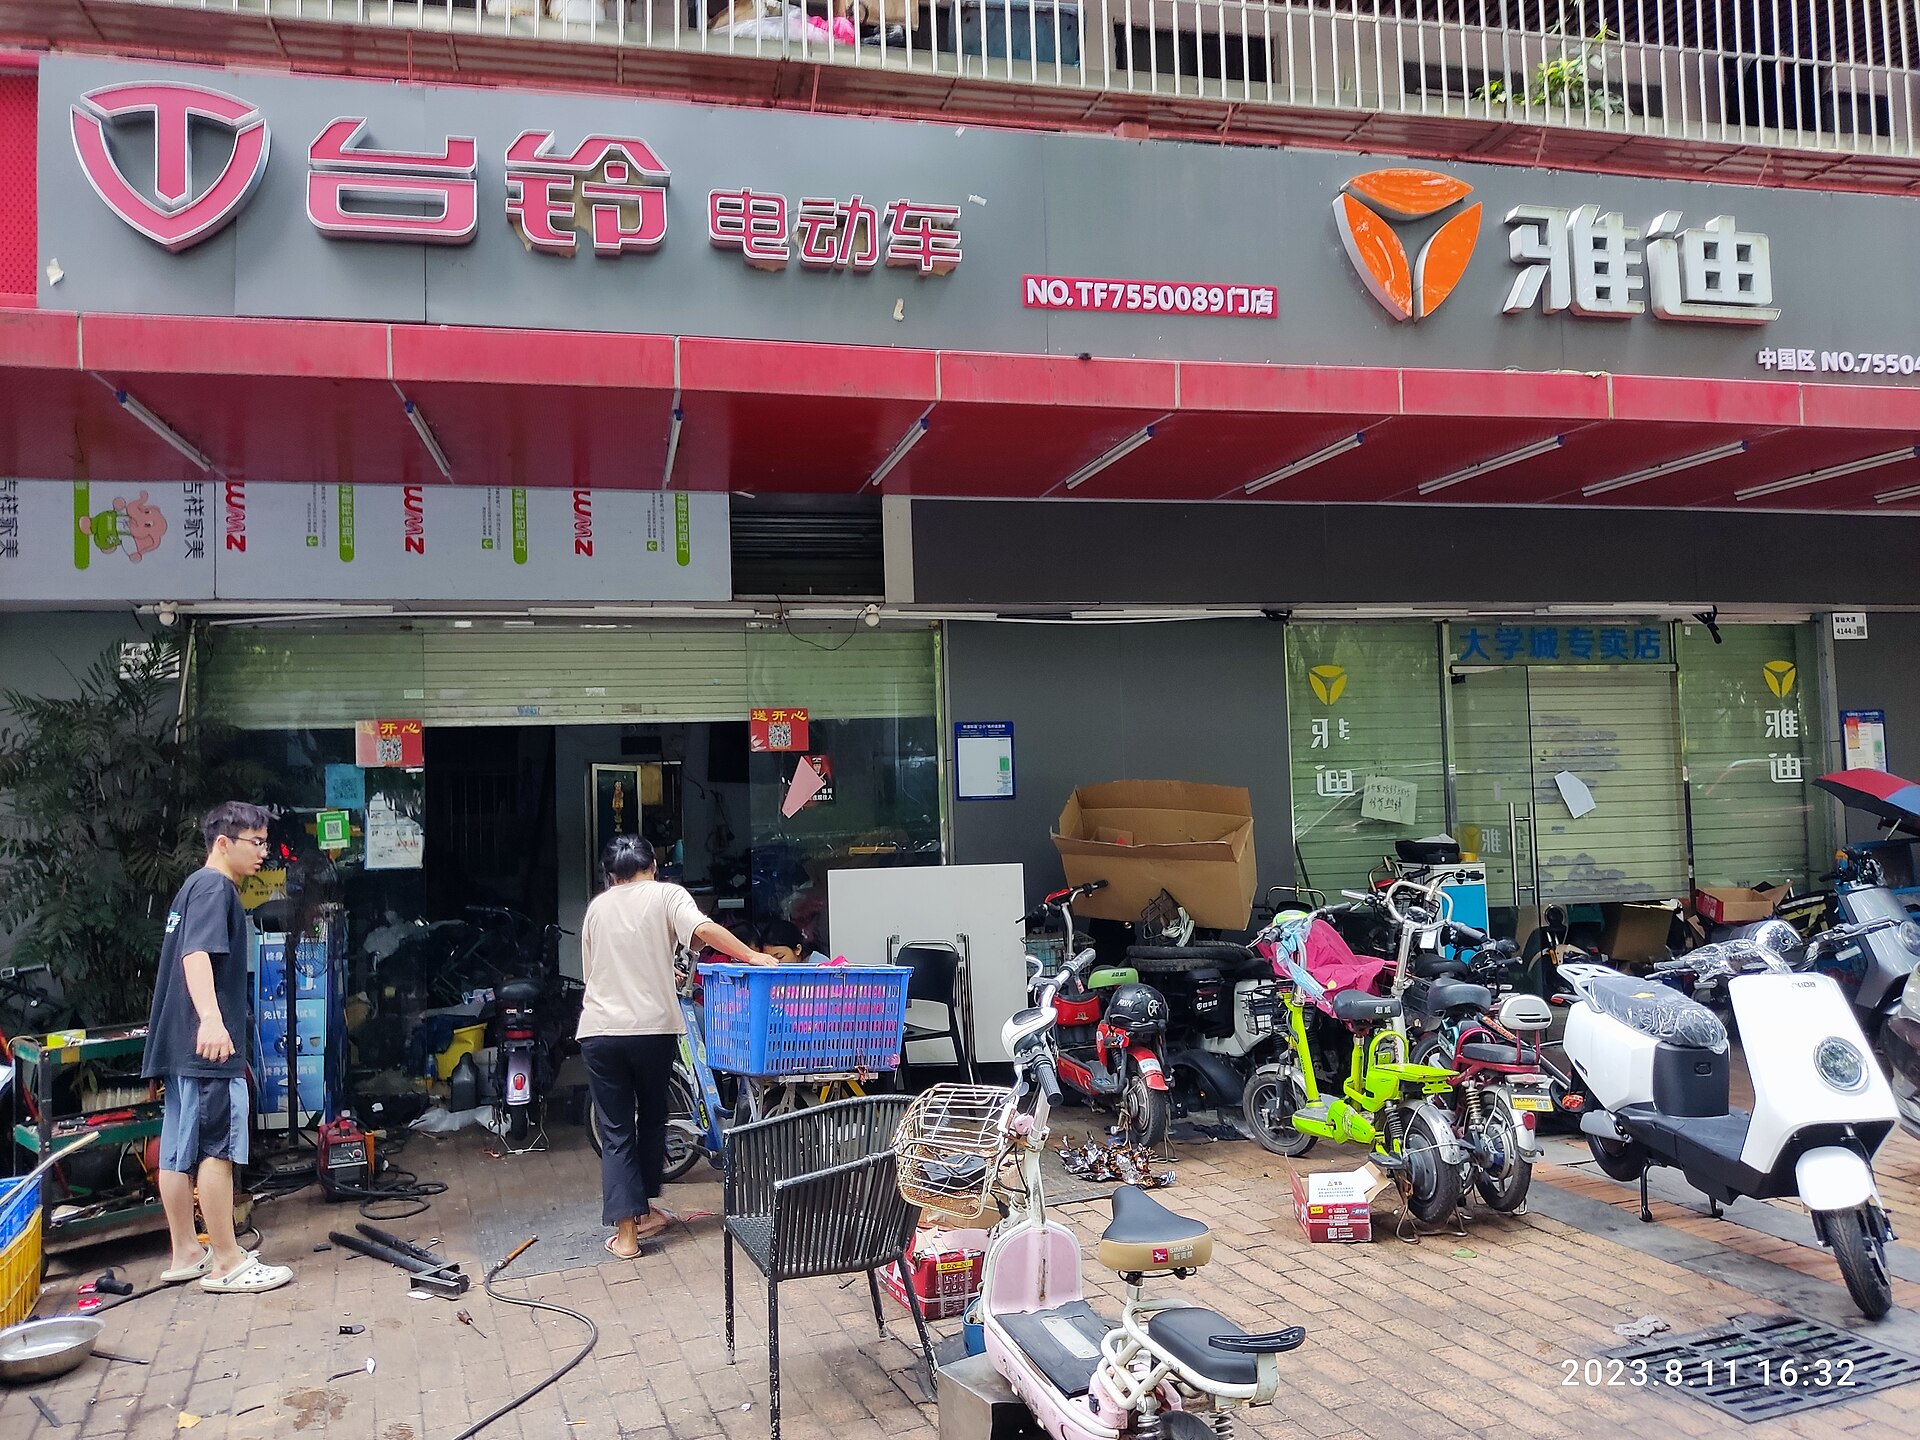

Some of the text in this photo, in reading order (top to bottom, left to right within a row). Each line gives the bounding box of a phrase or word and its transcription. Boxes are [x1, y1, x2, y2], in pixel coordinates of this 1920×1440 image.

[306, 115, 963, 273] 台铃 电动车
[1502, 203, 1782, 325] 雅迪
[1026, 278, 1275, 315] NO.TF7550089门店
[1758, 347, 1816, 371] 中国区
[1459, 627, 1661, 661] 大学城专卖店
[752, 710, 807, 722] 送开心
